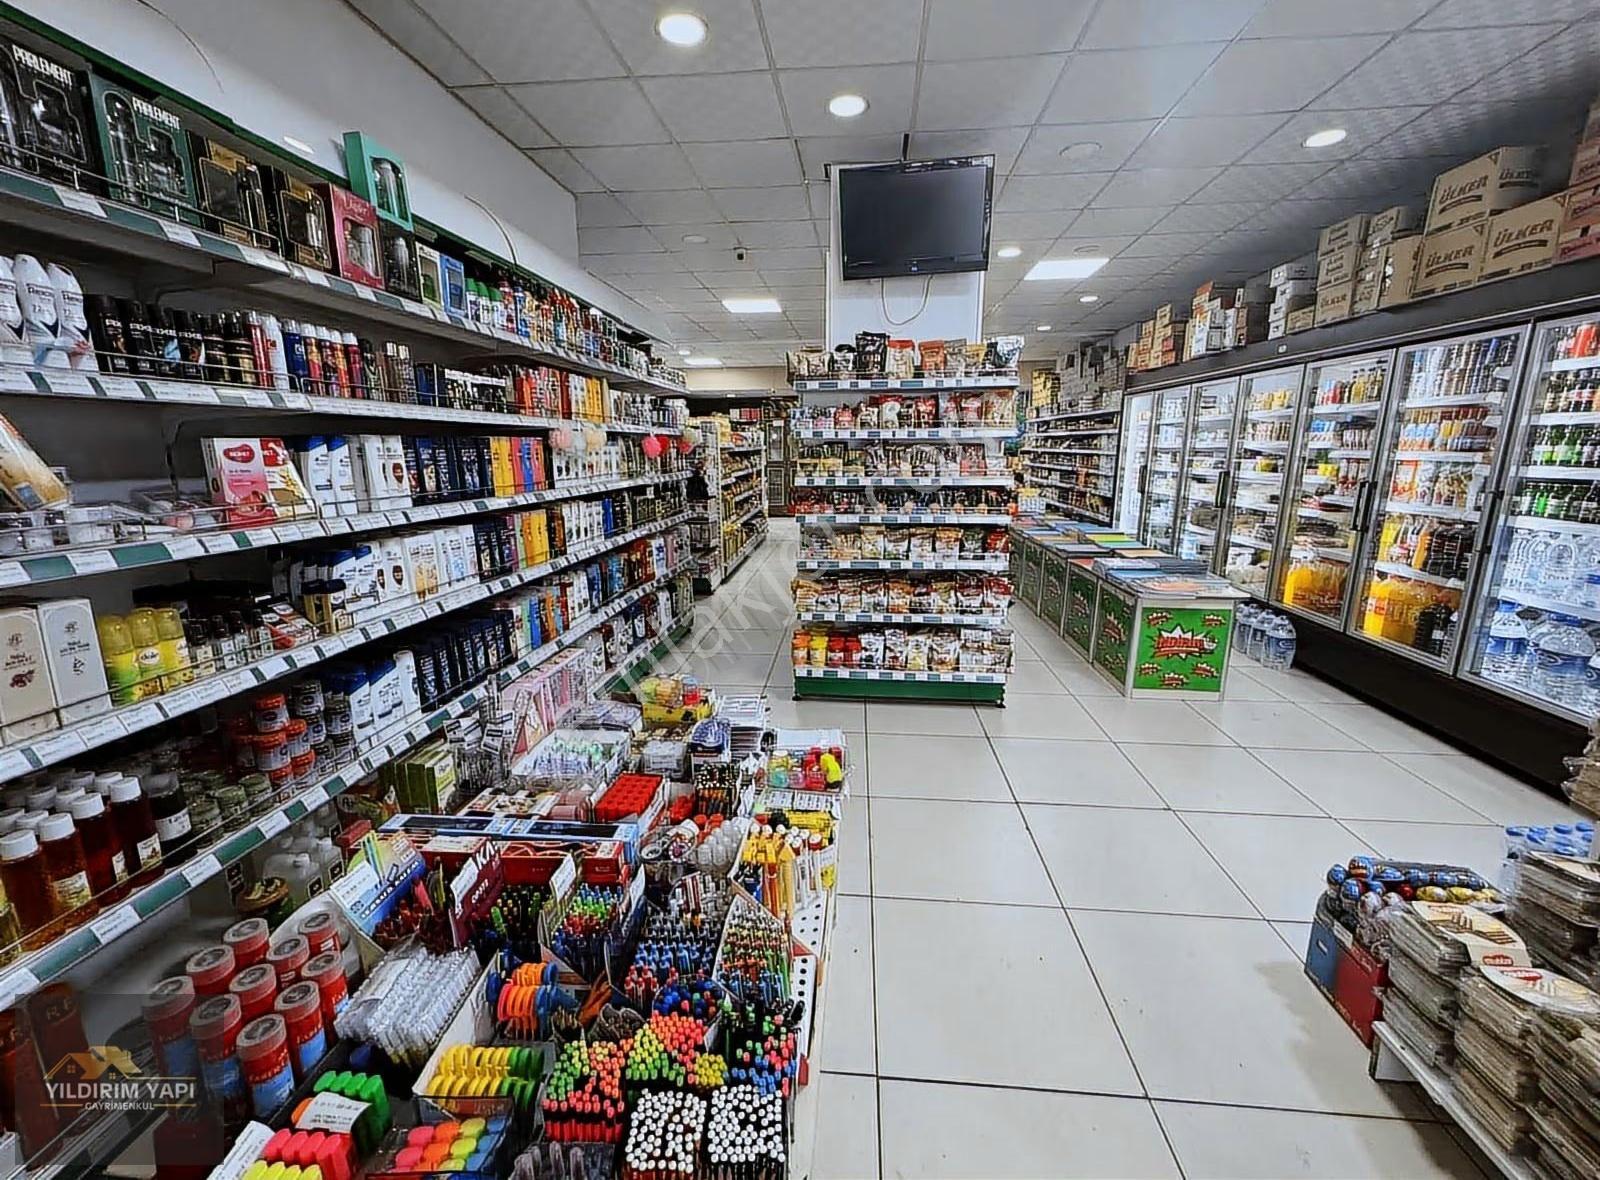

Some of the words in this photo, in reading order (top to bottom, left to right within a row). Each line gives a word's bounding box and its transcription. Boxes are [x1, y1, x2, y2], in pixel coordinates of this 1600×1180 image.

[1439, 174, 1489, 203] ÜLKER
[1494, 218, 1554, 249] ÜLKER
[1426, 244, 1475, 270] ÜLKER
